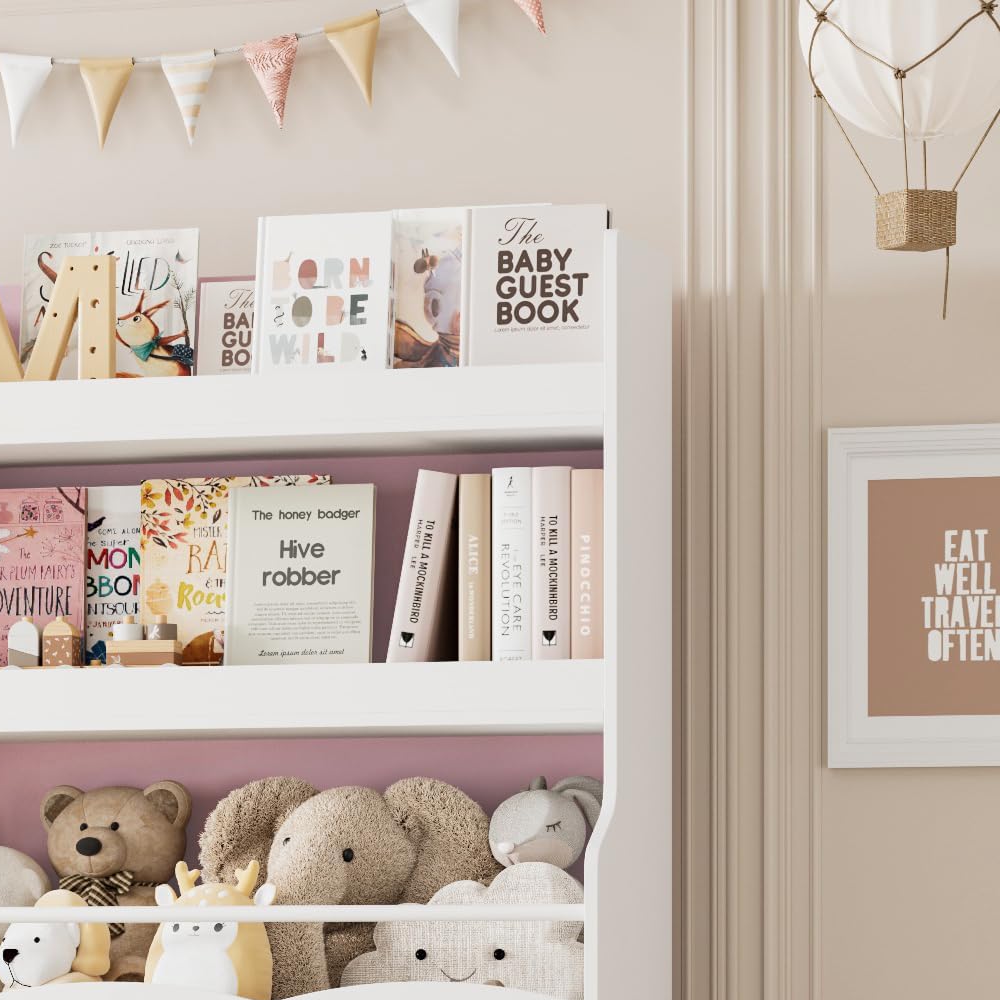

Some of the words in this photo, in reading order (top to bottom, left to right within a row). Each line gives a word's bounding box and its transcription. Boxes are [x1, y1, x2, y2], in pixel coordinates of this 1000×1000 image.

[498, 217, 544, 245] The
[498, 248, 573, 273] BABY
[271, 257, 370, 290] BORN
[496, 273, 589, 299] GUEST
[223, 312, 255, 330] BA
[270, 295, 312, 327] TO
[326, 294, 369, 326] BE
[497, 299, 579, 325] BOOK
[221, 331, 252, 349] GU
[221, 350, 253, 367] BO
[252, 509, 273, 520] The
[279, 509, 312, 521] honey
[317, 508, 361, 520] badger
[425, 520, 435, 531] TO
[548, 515, 558, 526] TO
[279, 539, 325, 559] Hive
[421, 532, 433, 550] KILL
[548, 528, 558, 546] KILL
[944, 528, 989, 562] EAT
[19, 547, 31, 559] The
[186, 540, 228, 574] RA
[409, 556, 417, 569] LEE
[420, 552, 429, 560] A
[467, 534, 479, 575] ALICE
[9, 563, 37, 580] PLUM
[262, 566, 342, 586] robber
[512, 564, 522, 589] EYE
[934, 561, 997, 596] WELL
[501, 543, 510, 637] REVOLUTION
[580, 535, 592, 637] PINOCCHIO
[512, 594, 522, 632] CARE
[927, 628, 1000, 662] OFTEN
